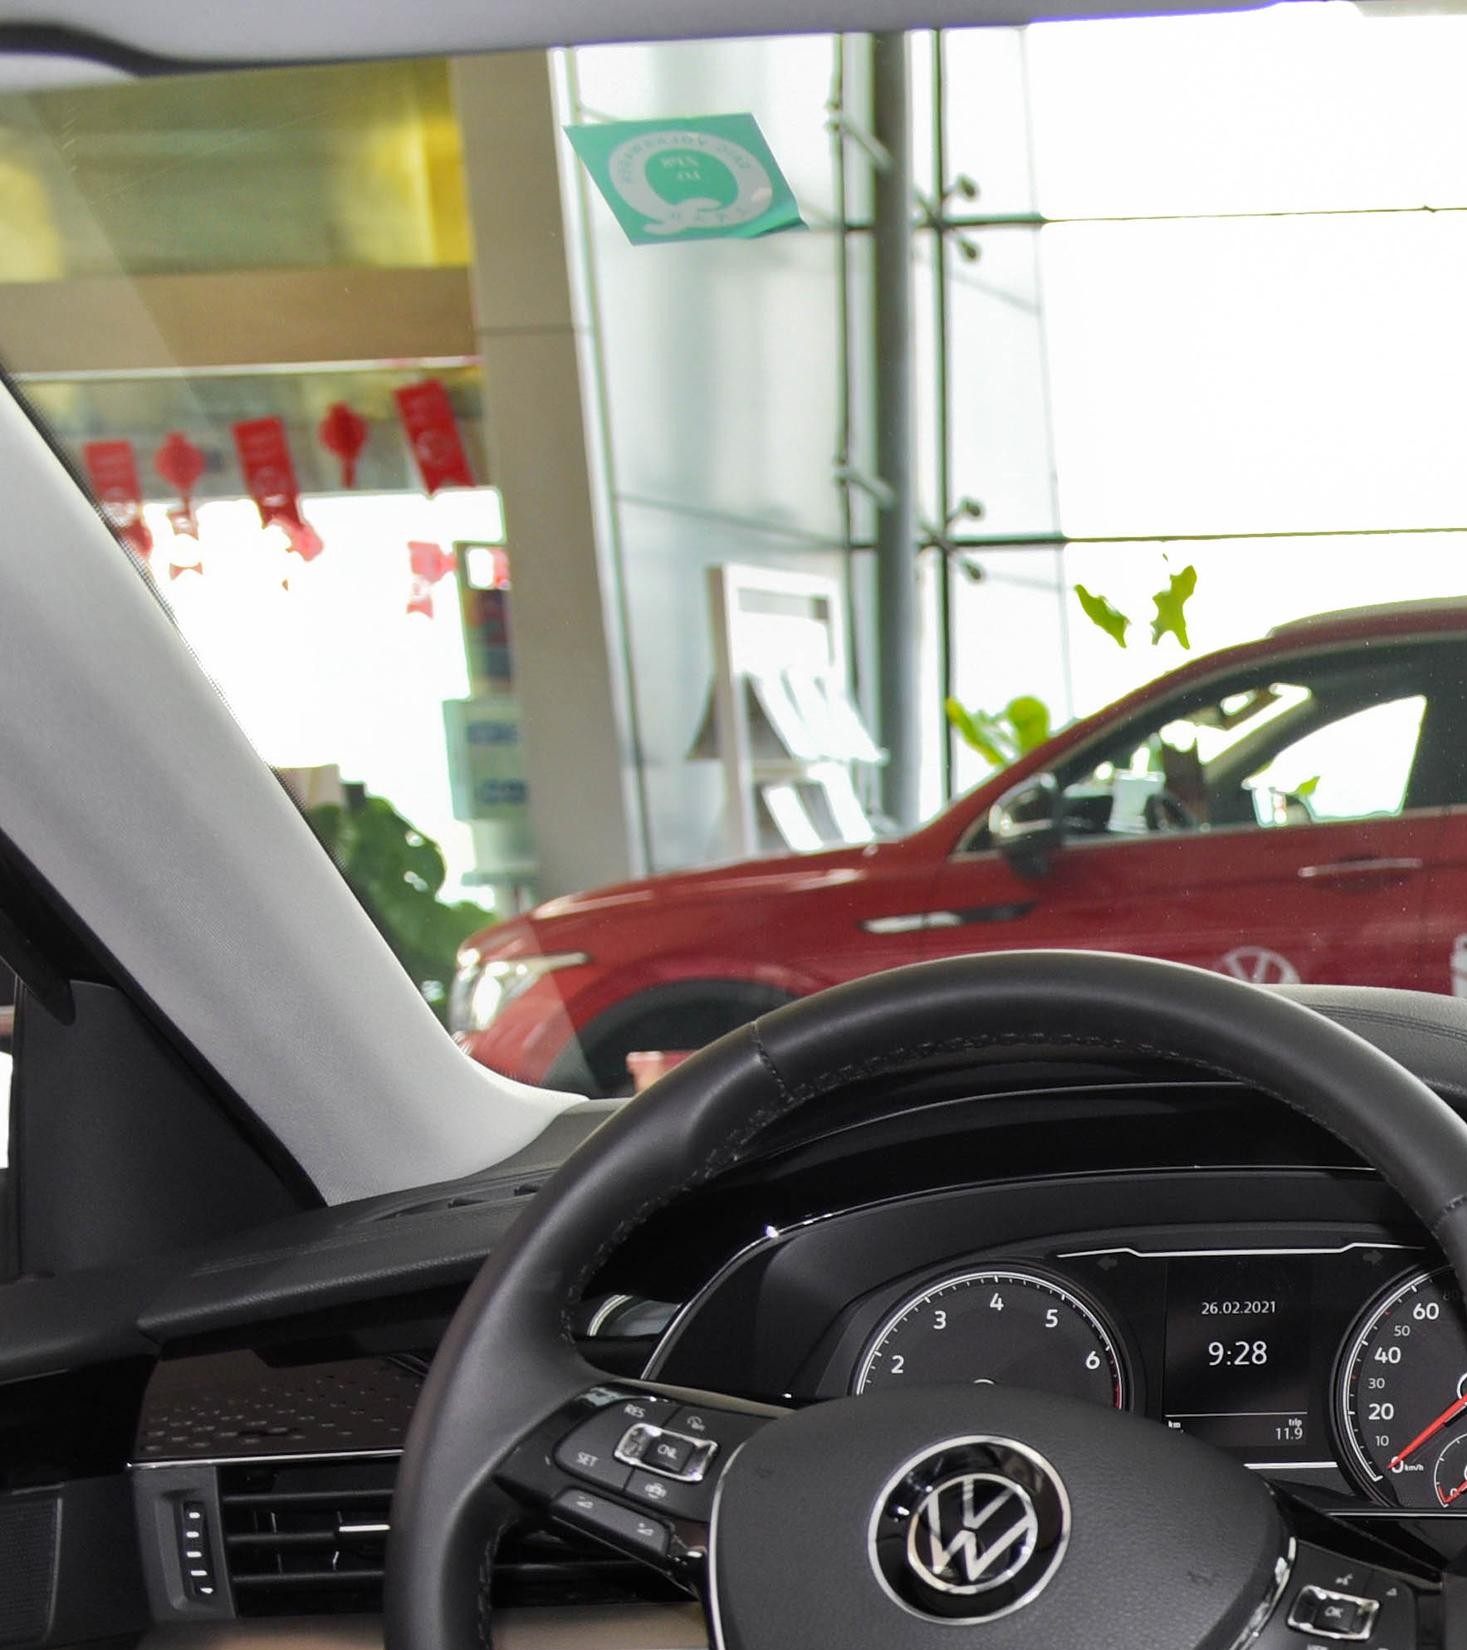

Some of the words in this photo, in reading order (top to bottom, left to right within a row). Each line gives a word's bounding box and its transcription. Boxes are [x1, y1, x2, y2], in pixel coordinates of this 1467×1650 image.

[989, 1292, 1004, 1311] 4
[1201, 1300, 1276, 1315] 26.02.2021
[1045, 1308, 1058, 1328] 5
[1412, 1302, 1440, 1320] 60
[933, 1310, 947, 1330] 3
[1393, 1324, 1411, 1337] 50
[1085, 1350, 1101, 1370] 6
[1208, 1340, 1268, 1366] 9:28
[1373, 1346, 1402, 1364] 40
[891, 1354, 905, 1374] 2
[1367, 1377, 1386, 1390] 30
[624, 1404, 645, 1418] RES
[1368, 1402, 1395, 1421] 20
[1167, 1420, 1182, 1429] km
[1288, 1417, 1303, 1429] trip
[1275, 1427, 1304, 1441] 11.9
[1375, 1434, 1390, 1447] 10
[577, 1452, 598, 1466] SET
[1404, 1463, 1425, 1472] km/h
